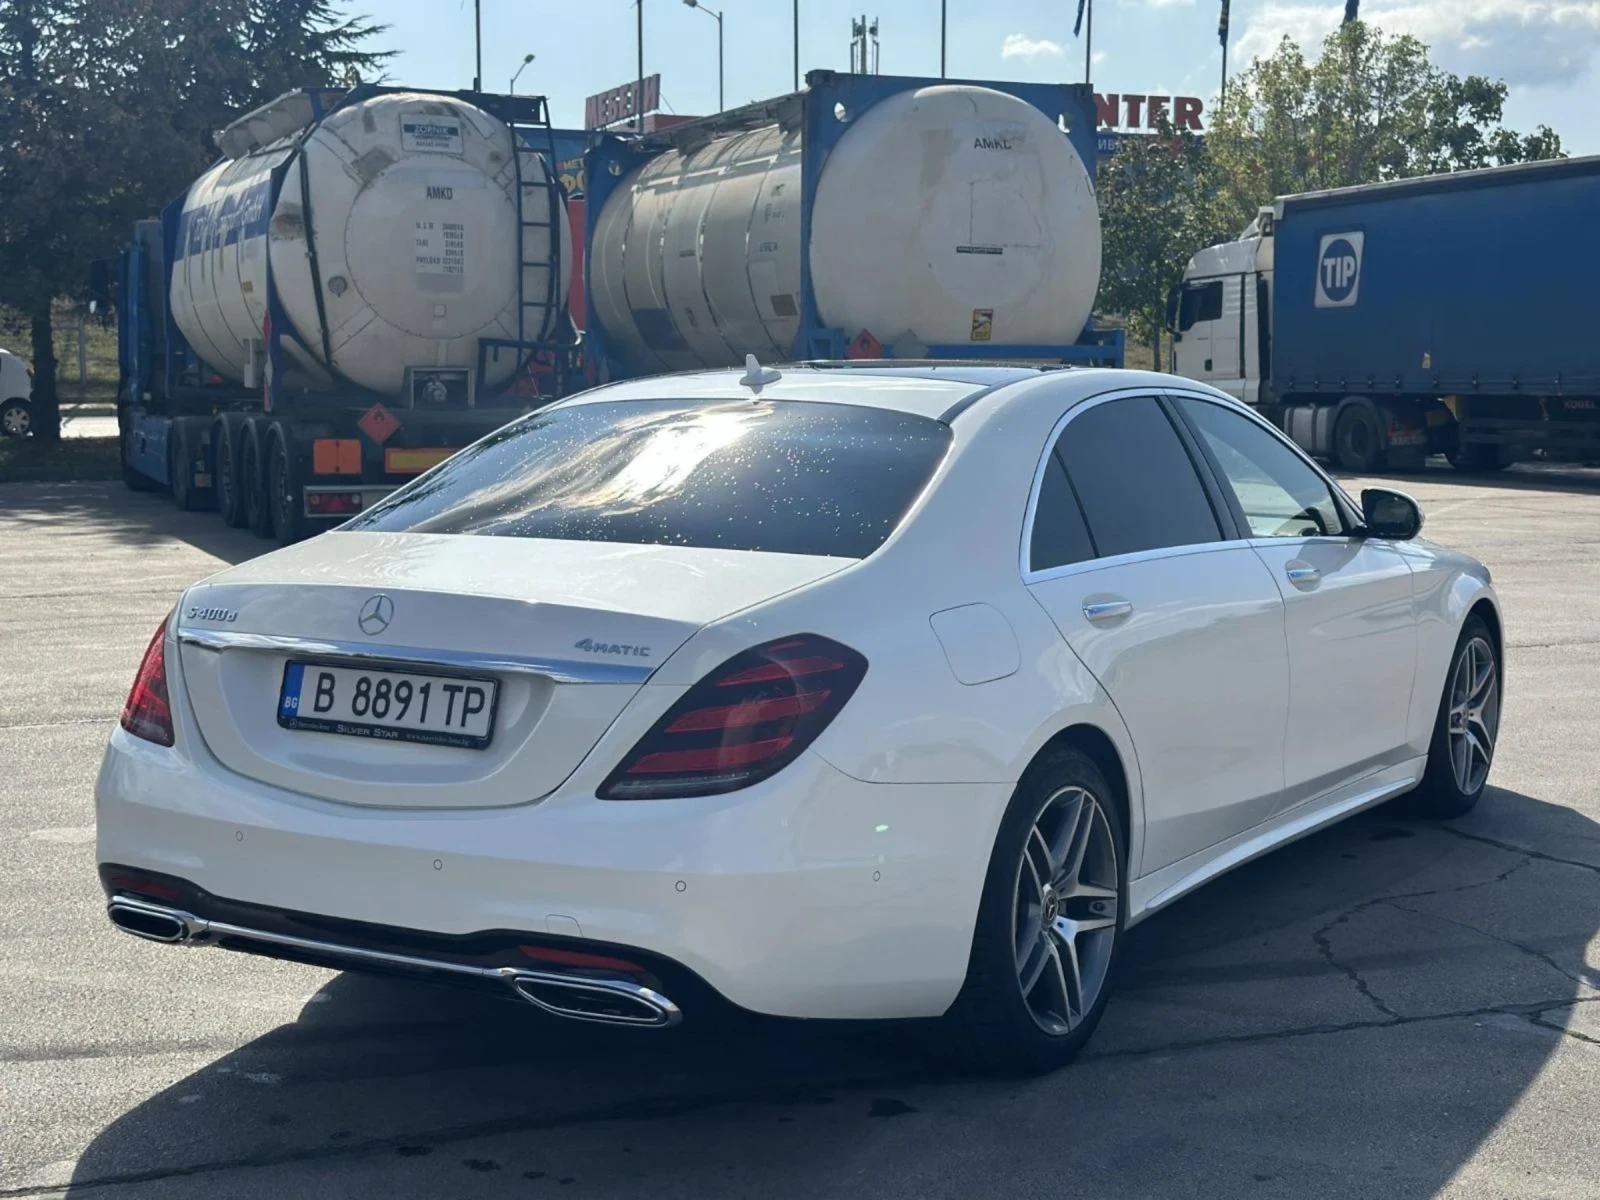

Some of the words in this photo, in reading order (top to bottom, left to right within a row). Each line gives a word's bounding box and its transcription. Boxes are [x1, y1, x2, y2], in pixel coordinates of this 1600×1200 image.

[1323, 256, 1356, 288] TIP
[574, 638, 651, 657] 4MATIC
[283, 696, 299, 709] BG
[314, 672, 336, 713] B
[352, 676, 431, 724] 8891
[442, 683, 485, 728] TP
